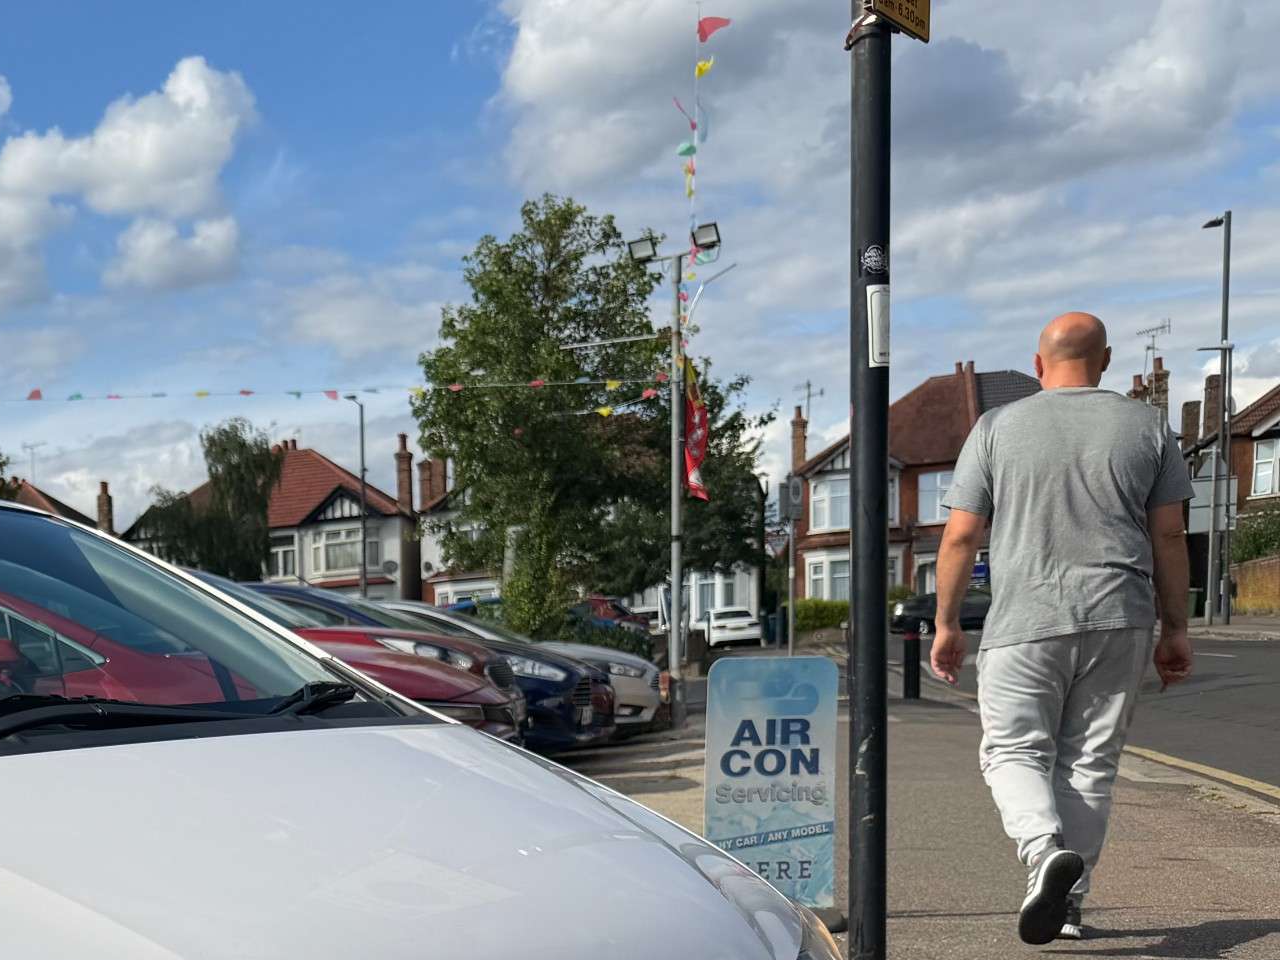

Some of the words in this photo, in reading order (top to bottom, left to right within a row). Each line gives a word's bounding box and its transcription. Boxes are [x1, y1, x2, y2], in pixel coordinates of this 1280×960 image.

[730, 718, 811, 747] AIR
[720, 748, 820, 778] CON
[715, 781, 826, 806] Servicing
[735, 837, 758, 849] CAR
[767, 830, 788, 842] ANY
[791, 823, 829, 837] MODEL
[745, 860, 812, 880] ERE
